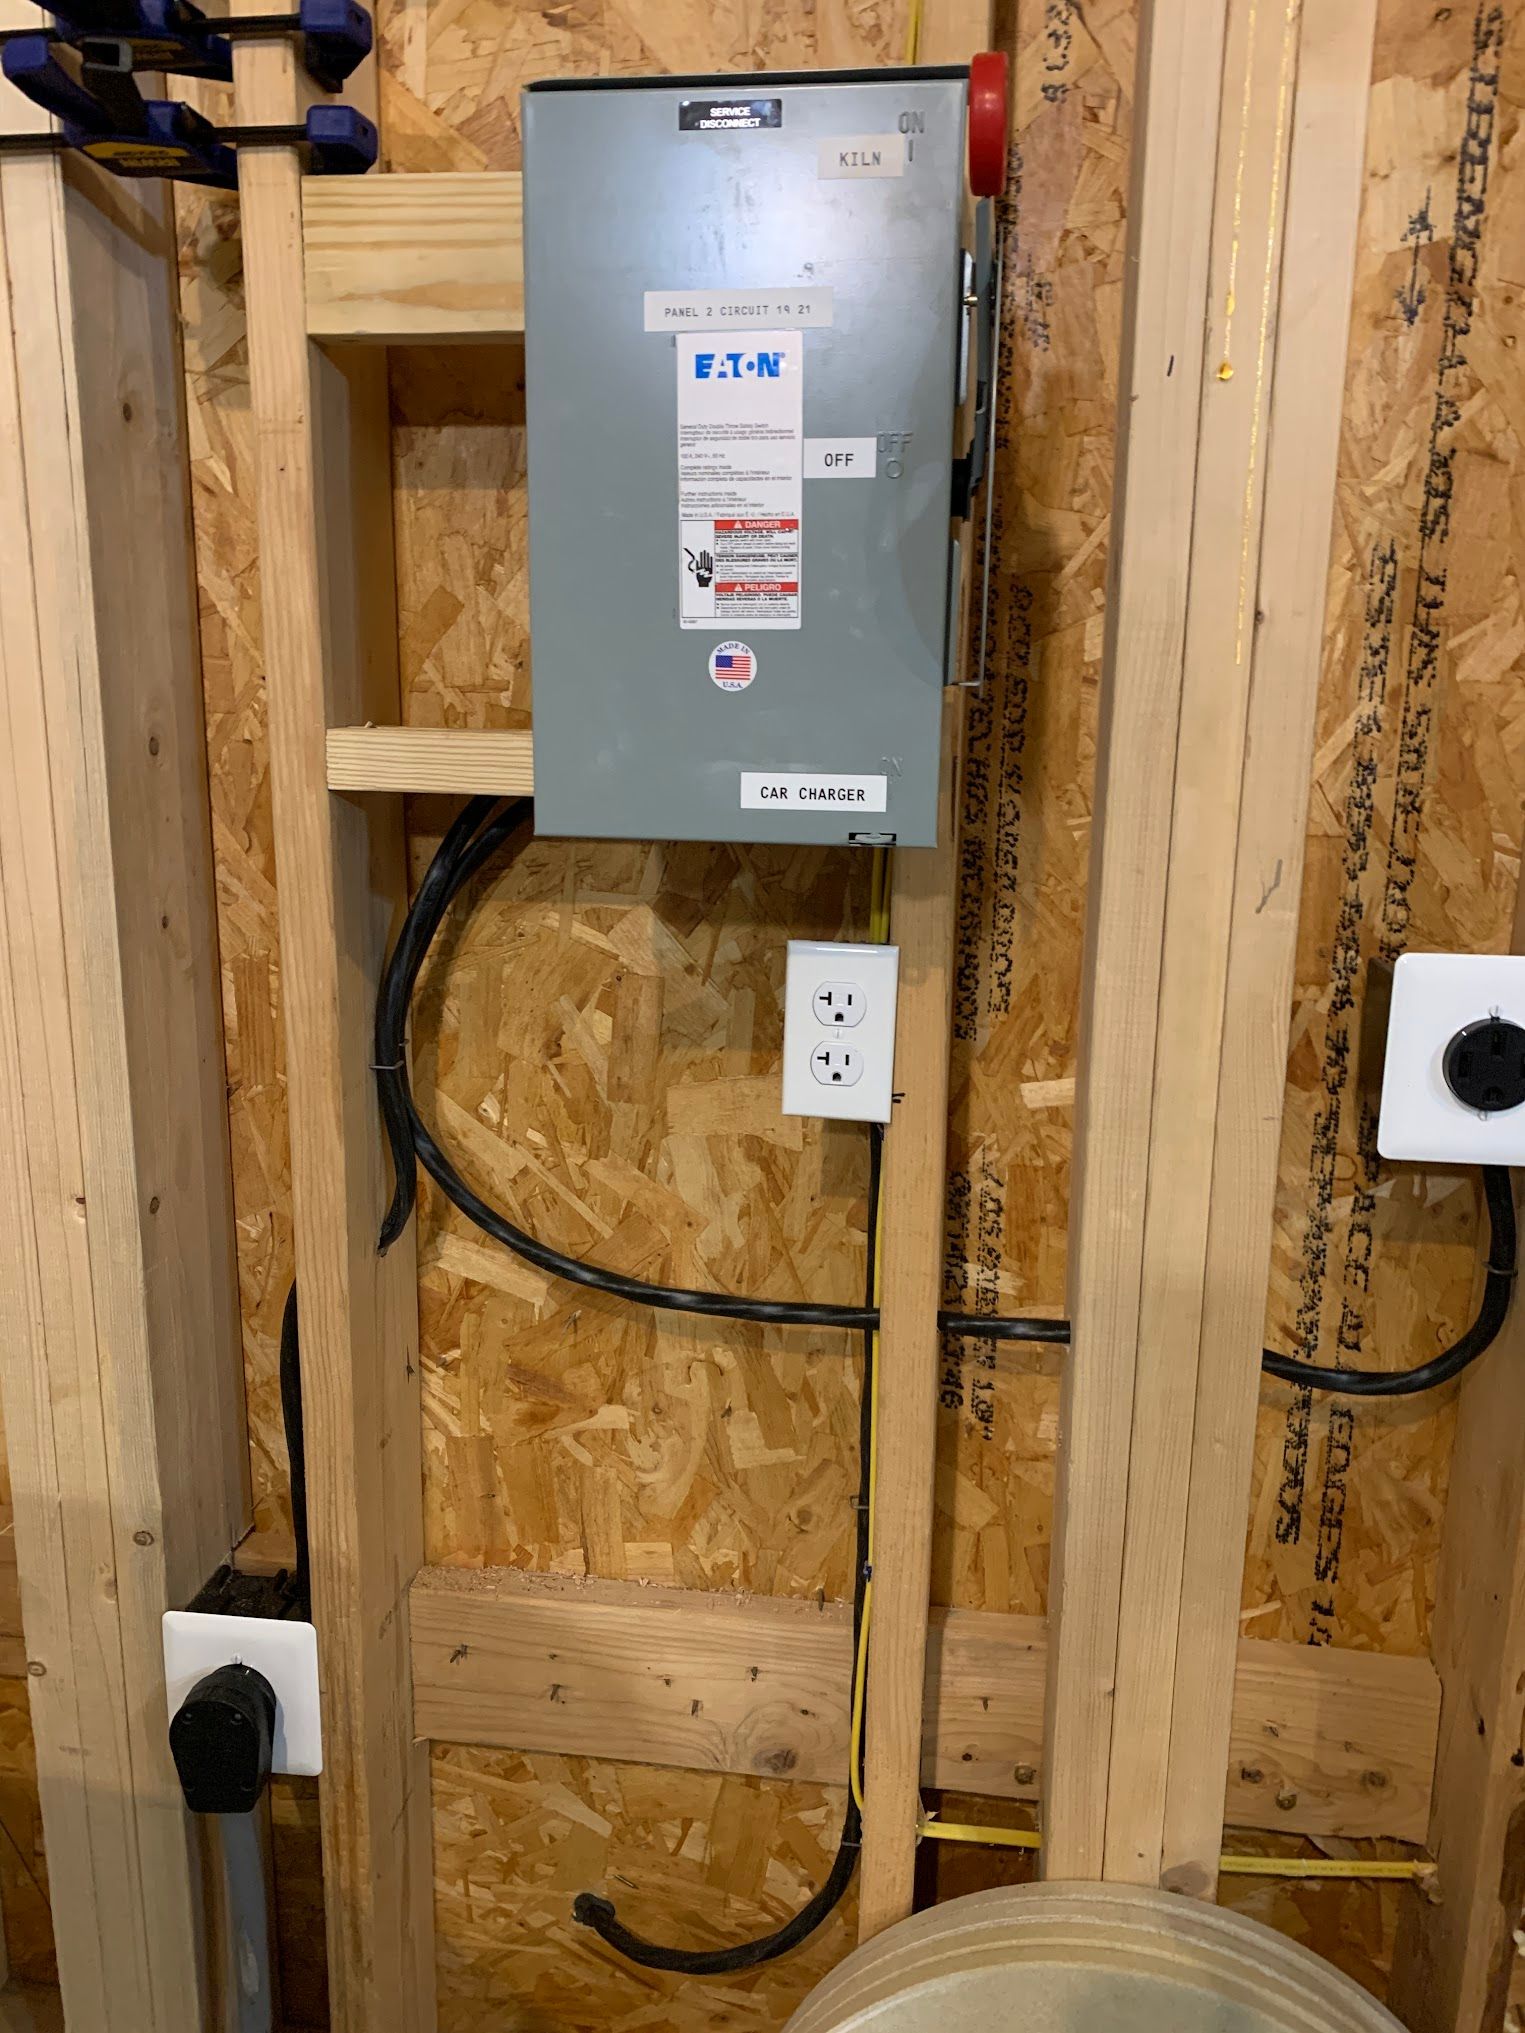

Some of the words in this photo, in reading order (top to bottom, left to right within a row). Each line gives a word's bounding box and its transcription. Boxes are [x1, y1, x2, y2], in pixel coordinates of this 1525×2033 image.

[710, 106, 751, 118] SERVICE
[700, 117, 761, 129] DISCONNECT
[897, 111, 926, 134] ON
[839, 151, 882, 167] KILN
[664, 307, 699, 318] PANEL
[706, 306, 713, 317] 2
[720, 305, 769, 317] CIRCUIT
[776, 304, 790, 315] 19
[797, 304, 811, 315] 21
[695, 352, 781, 379] EATON
[824, 453, 854, 468] OFF
[745, 521, 781, 529] DANGER
[745, 583, 781, 591] PELIGRO
[716, 643, 740, 654] MADE
[740, 646, 751, 655] IN
[760, 786, 788, 800] CAR
[799, 787, 865, 802] CHARGER
